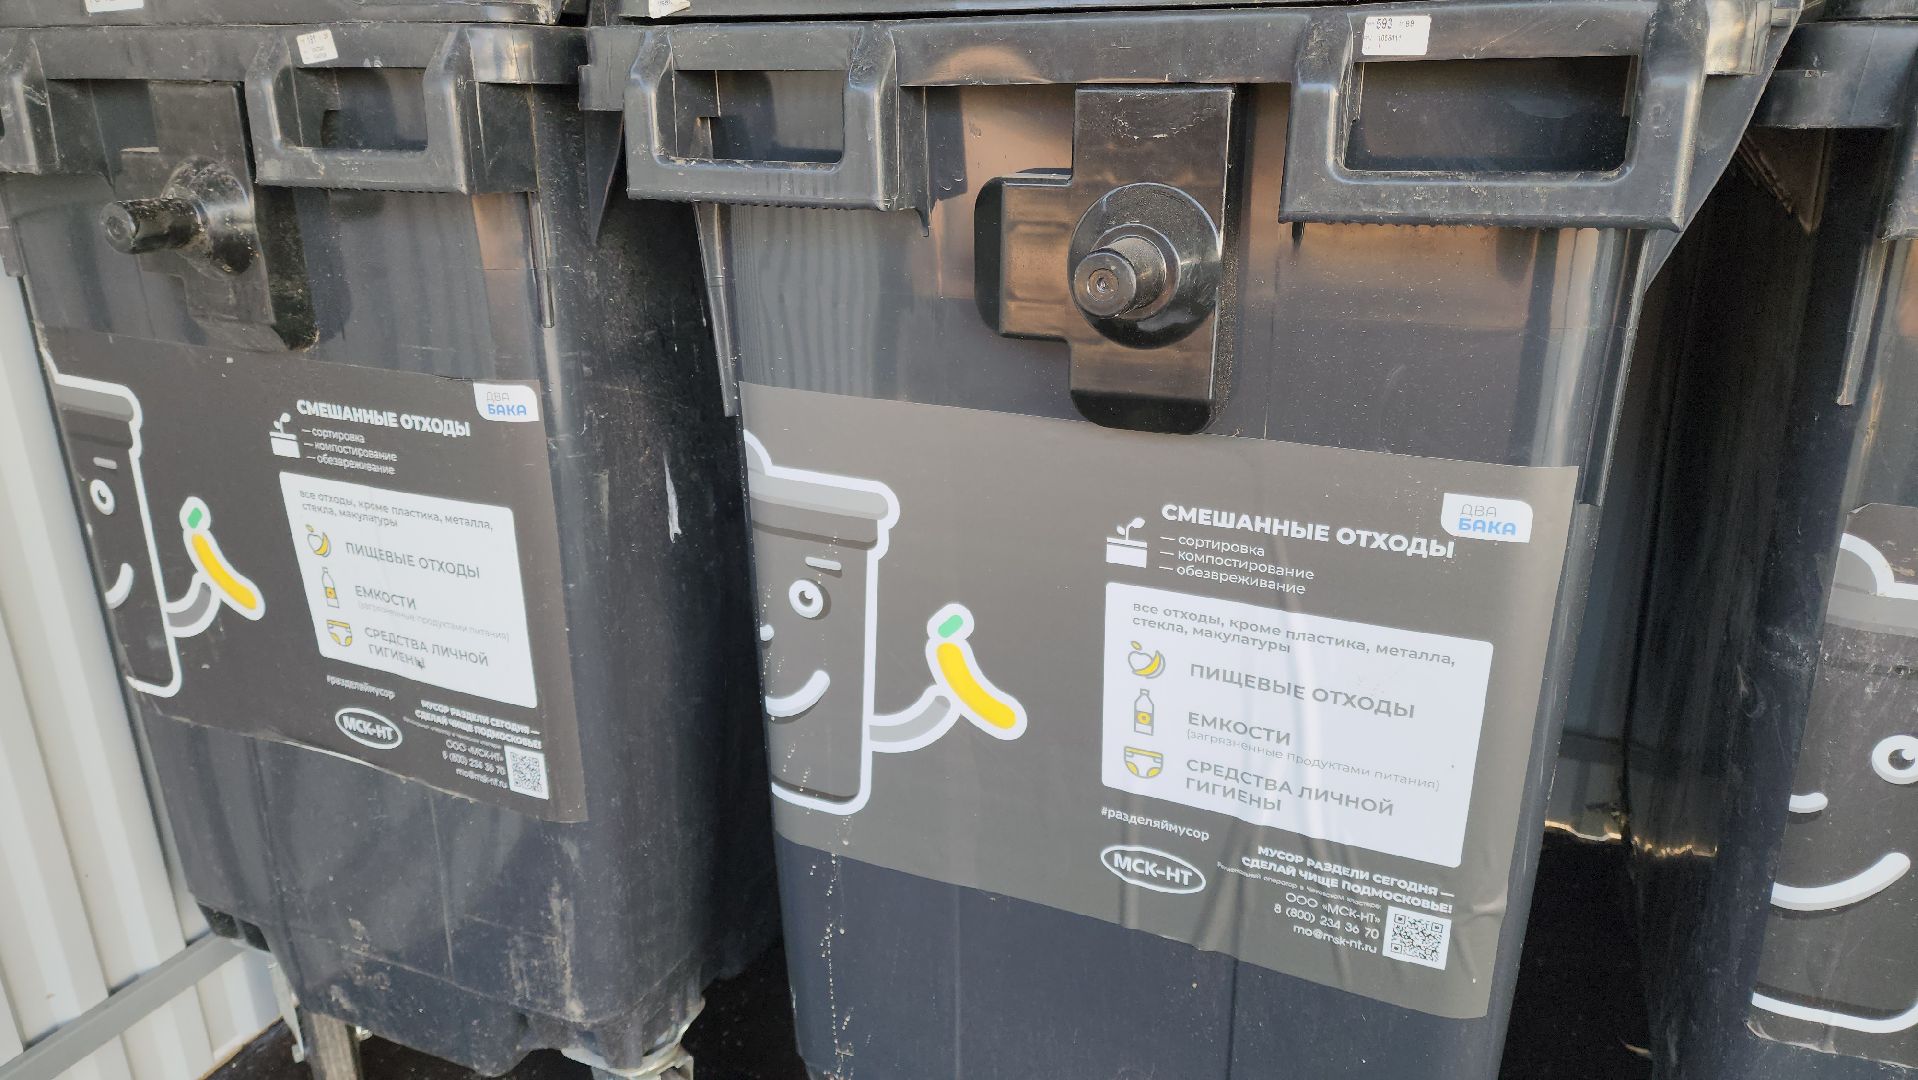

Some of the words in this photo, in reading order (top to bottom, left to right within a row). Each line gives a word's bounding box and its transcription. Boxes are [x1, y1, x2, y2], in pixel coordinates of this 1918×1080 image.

[486, 391, 510, 401] ДВА
[487, 403, 527, 416] БАКА
[296, 399, 399, 428] СМЕШАННЫЕ
[400, 413, 471, 438] ОТХОДЫ
[311, 427, 366, 444] сортировка
[314, 441, 398, 462] компостирование
[316, 453, 396, 475] обезвреживание
[300, 490, 316, 500] все
[318, 493, 356, 508] отходы,
[358, 499, 389, 514] кроме
[391, 507, 443, 524] пластика,
[445, 516, 494, 532] металла,
[302, 502, 337, 517] стекла,
[339, 509, 398, 528] макулатуры
[1459, 503, 1498, 518] ДВА
[1161, 504, 1331, 542] СМЕШАННЫЕ
[1336, 527, 1455, 558] ОТХОДЫ
[1457, 517, 1517, 537] БАКА
[345, 542, 415, 567] ПИЩЕВЫЕ
[418, 557, 480, 579] ОТХОДЫ
[1178, 535, 1265, 557] сортировка
[1176, 564, 1306, 595] обезвреживание
[1177, 550, 1315, 580] компостирование
[354, 585, 417, 610] ЕМКОСТИ
[364, 627, 429, 652] СРЕДСТВА
[432, 643, 489, 667] ЛИЧНОЙ
[469, 626, 510, 643] питания)
[1132, 617, 1188, 636] стекла,
[1192, 627, 1291, 654] макулатуры
[1133, 603, 1158, 615] все
[1163, 607, 1225, 627] отходы,
[1229, 619, 1282, 636] кроме
[1286, 630, 1370, 653] пластика,
[1376, 644, 1456, 667] металла,
[368, 643, 426, 668] ГИГИЕНЫ
[1190, 663, 1306, 700] ПИЩЕВЫЕ
[1311, 687, 1415, 719] ОТХОДЫ
[342, 715, 393, 741] МСК-НТ
[414, 709, 449, 726] СДЕЛАЙ
[420, 699, 450, 714] МУСОР
[450, 707, 490, 725] РАЗДЕЛИ
[490, 717, 530, 735] СЕГОДНЯ
[1187, 711, 1292, 746] ЕМКОСТИ
[445, 739, 468, 752] ООО
[1186, 758, 1293, 795] СРЕДСТВА
[1297, 785, 1395, 817] ЛИЧНОЙ
[1286, 752, 1370, 776] продуктами
[1373, 771, 1440, 792] питания)
[1185, 777, 1282, 812] ГИГИЕНЫ
[1100, 806, 1211, 842] #разделяймусор
[1113, 853, 1193, 886] МСК-НТ
[1241, 856, 1297, 877] СДЕЛАЙ
[1298, 868, 1339, 889] ЧИЩЕ
[1341, 880, 1454, 914] ПОДМОСКОВЬЕ!
[1257, 845, 1305, 864] МУСОР
[1306, 857, 1370, 881] РАЗДЕЛИ
[1372, 873, 1439, 896] СЕГОДНЯ
[1273, 903, 1282, 914] 8
[1285, 907, 1316, 924] (800)
[1319, 915, 1341, 930] 234
[1344, 922, 1360, 934] 36
[1364, 927, 1380, 940] 70
[1285, 892, 1319, 908] ООО
[1321, 902, 1381, 924] «МСК-НТ»
[1292, 924, 1378, 954] mo@msk-nt.ru
